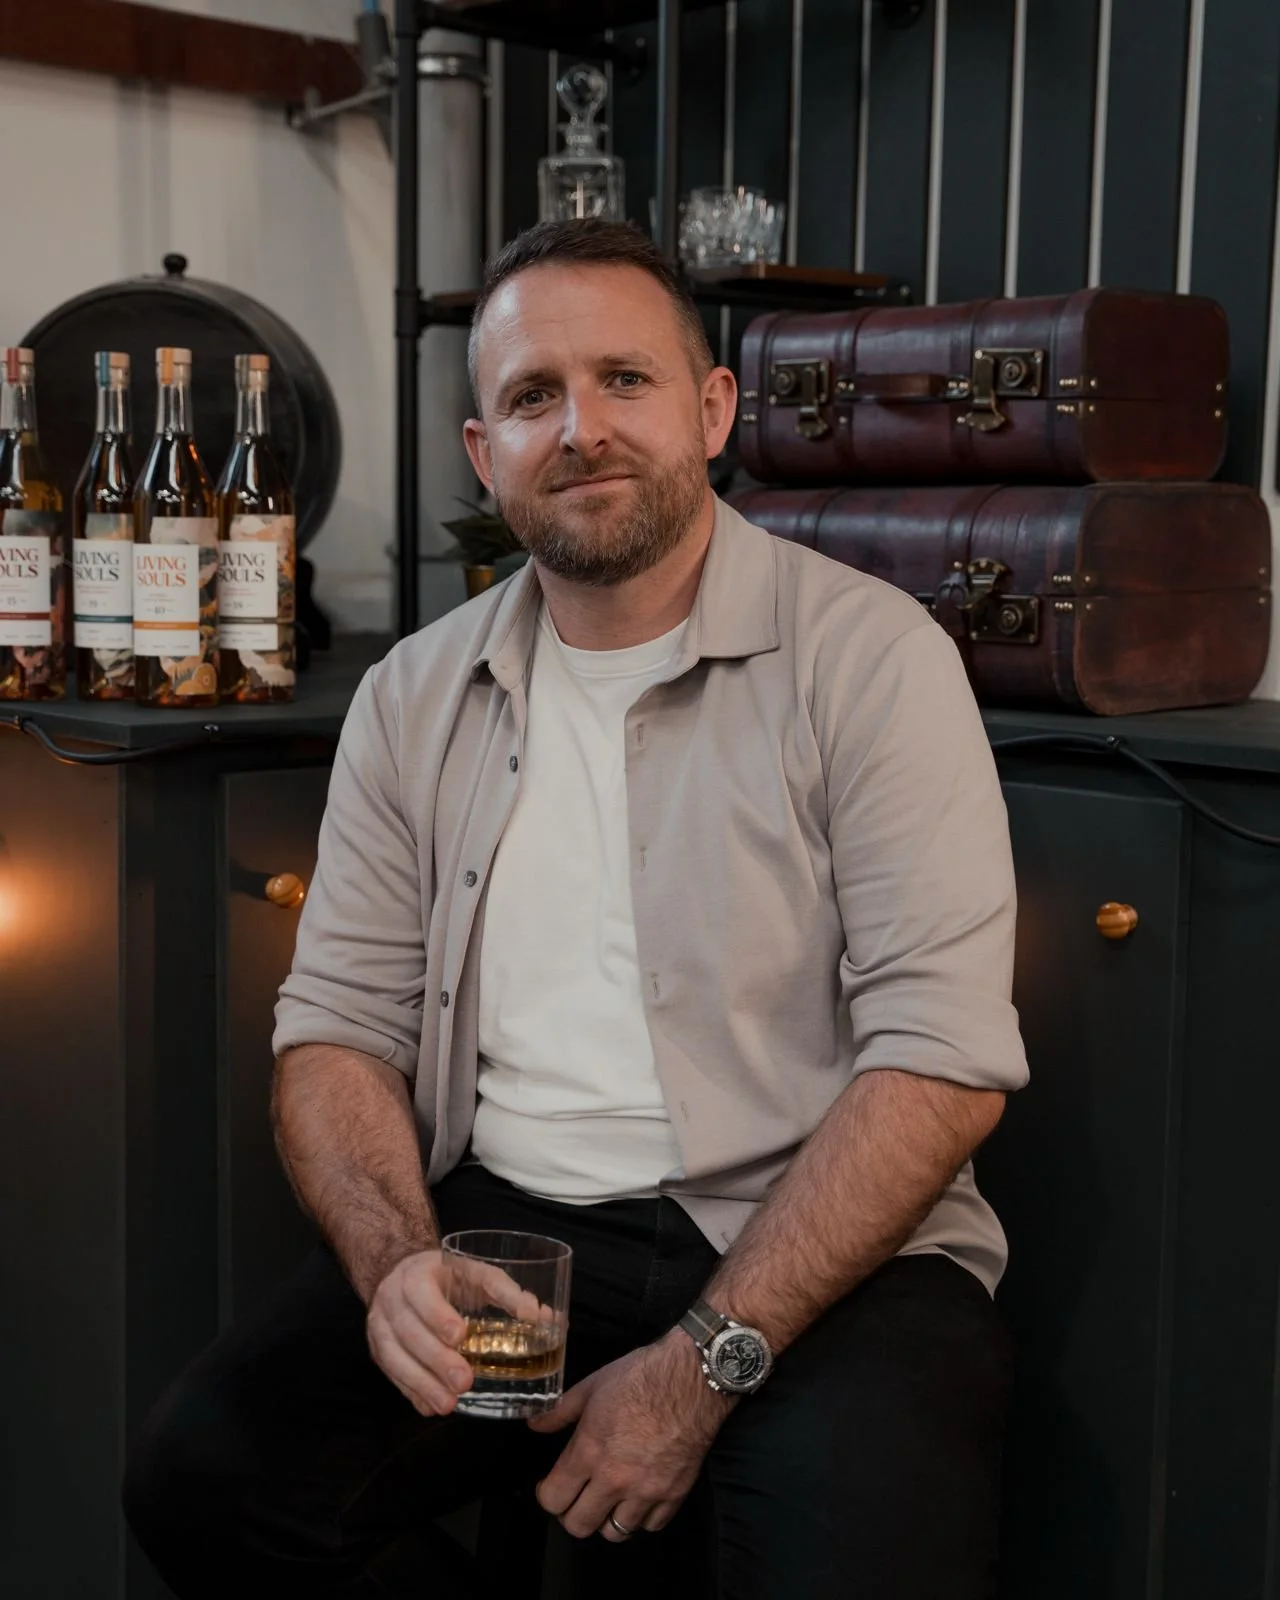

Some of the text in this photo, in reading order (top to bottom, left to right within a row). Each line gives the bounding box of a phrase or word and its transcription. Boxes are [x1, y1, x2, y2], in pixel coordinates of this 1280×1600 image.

[136, 555, 187, 571] LIVING
[75, 567, 119, 581] SOULS
[136, 572, 187, 587] SOULS
[217, 568, 265, 582] SOULS
